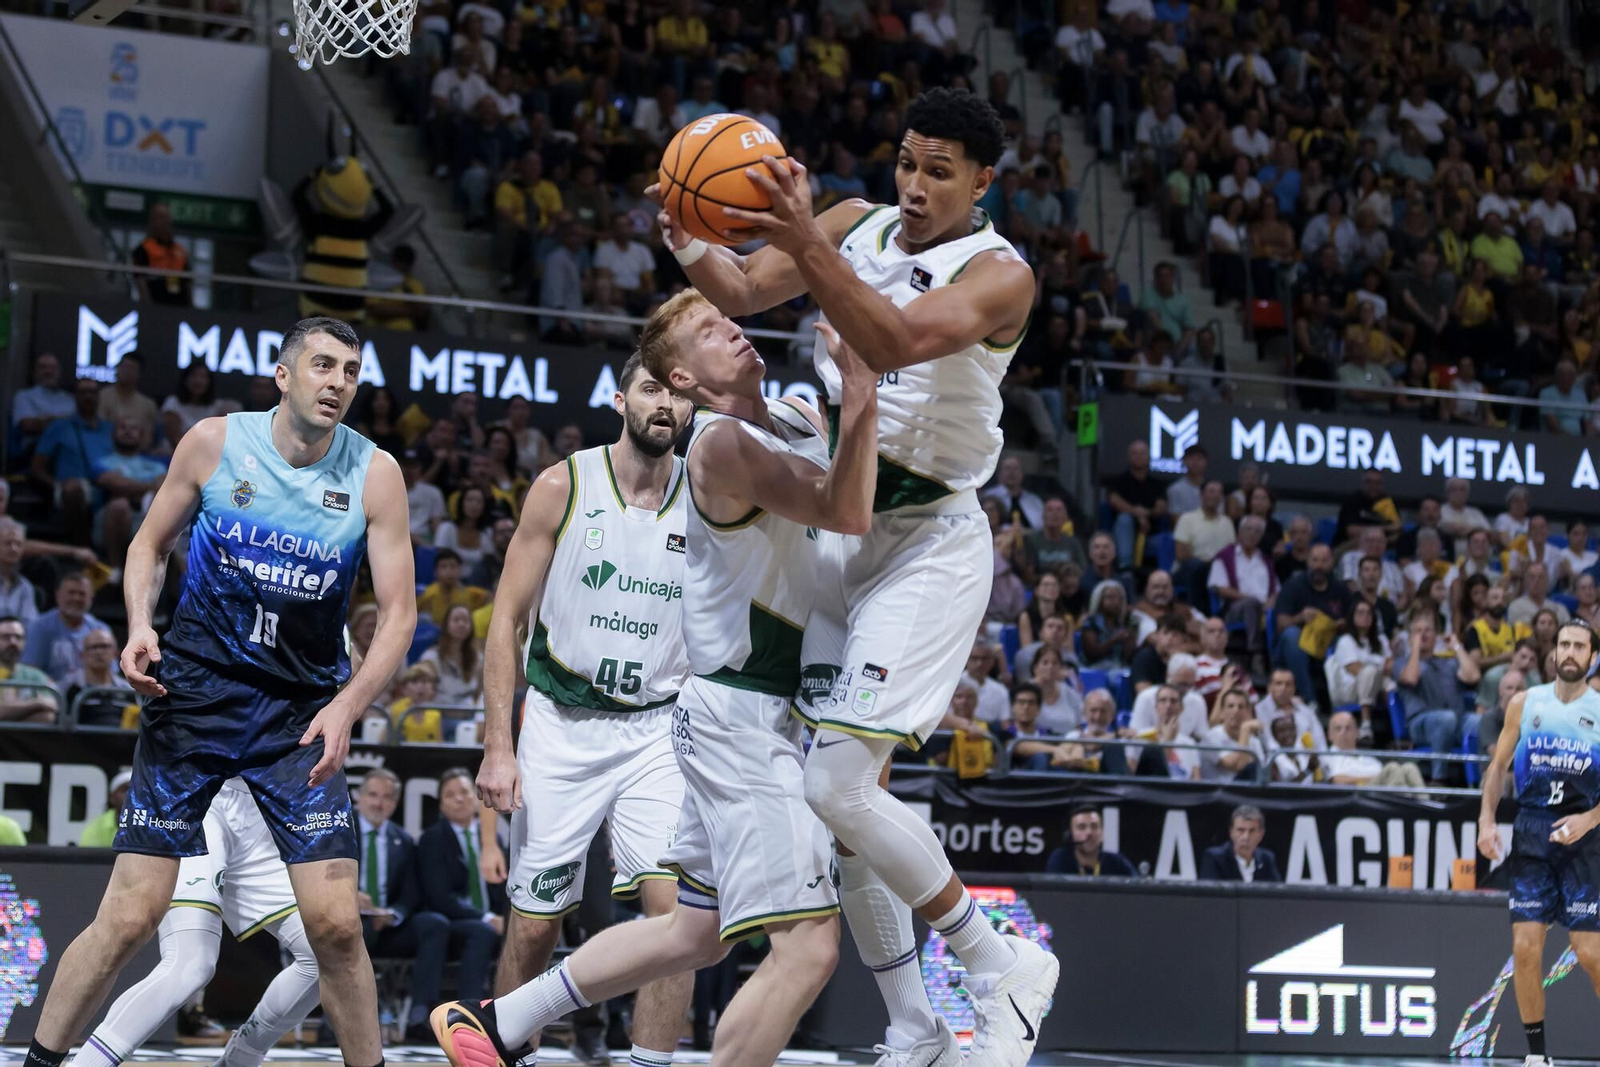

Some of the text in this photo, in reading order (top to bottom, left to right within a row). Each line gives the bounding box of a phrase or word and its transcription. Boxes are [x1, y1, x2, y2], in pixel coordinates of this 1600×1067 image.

[105, 111, 207, 155] DXT
[177, 320, 386, 387] MADA
[410, 344, 559, 403] METAL
[1231, 416, 1402, 473] MADERA
[1421, 433, 1545, 486] METAL
[216, 516, 342, 564] LA LAGUNA
[261, 583, 316, 600] emociones
[617, 573, 683, 602] Unicaja
[249, 603, 280, 648] 19
[589, 611, 659, 640] málaga
[594, 657, 644, 696] 45
[863, 669, 881, 680] acb
[1528, 735, 1592, 756] LA LAGUNA
[1547, 780, 1565, 805] 15
[305, 812, 332, 823] Islas
[931, 817, 1045, 855] portes
[1245, 980, 1437, 1037] LOTUS
